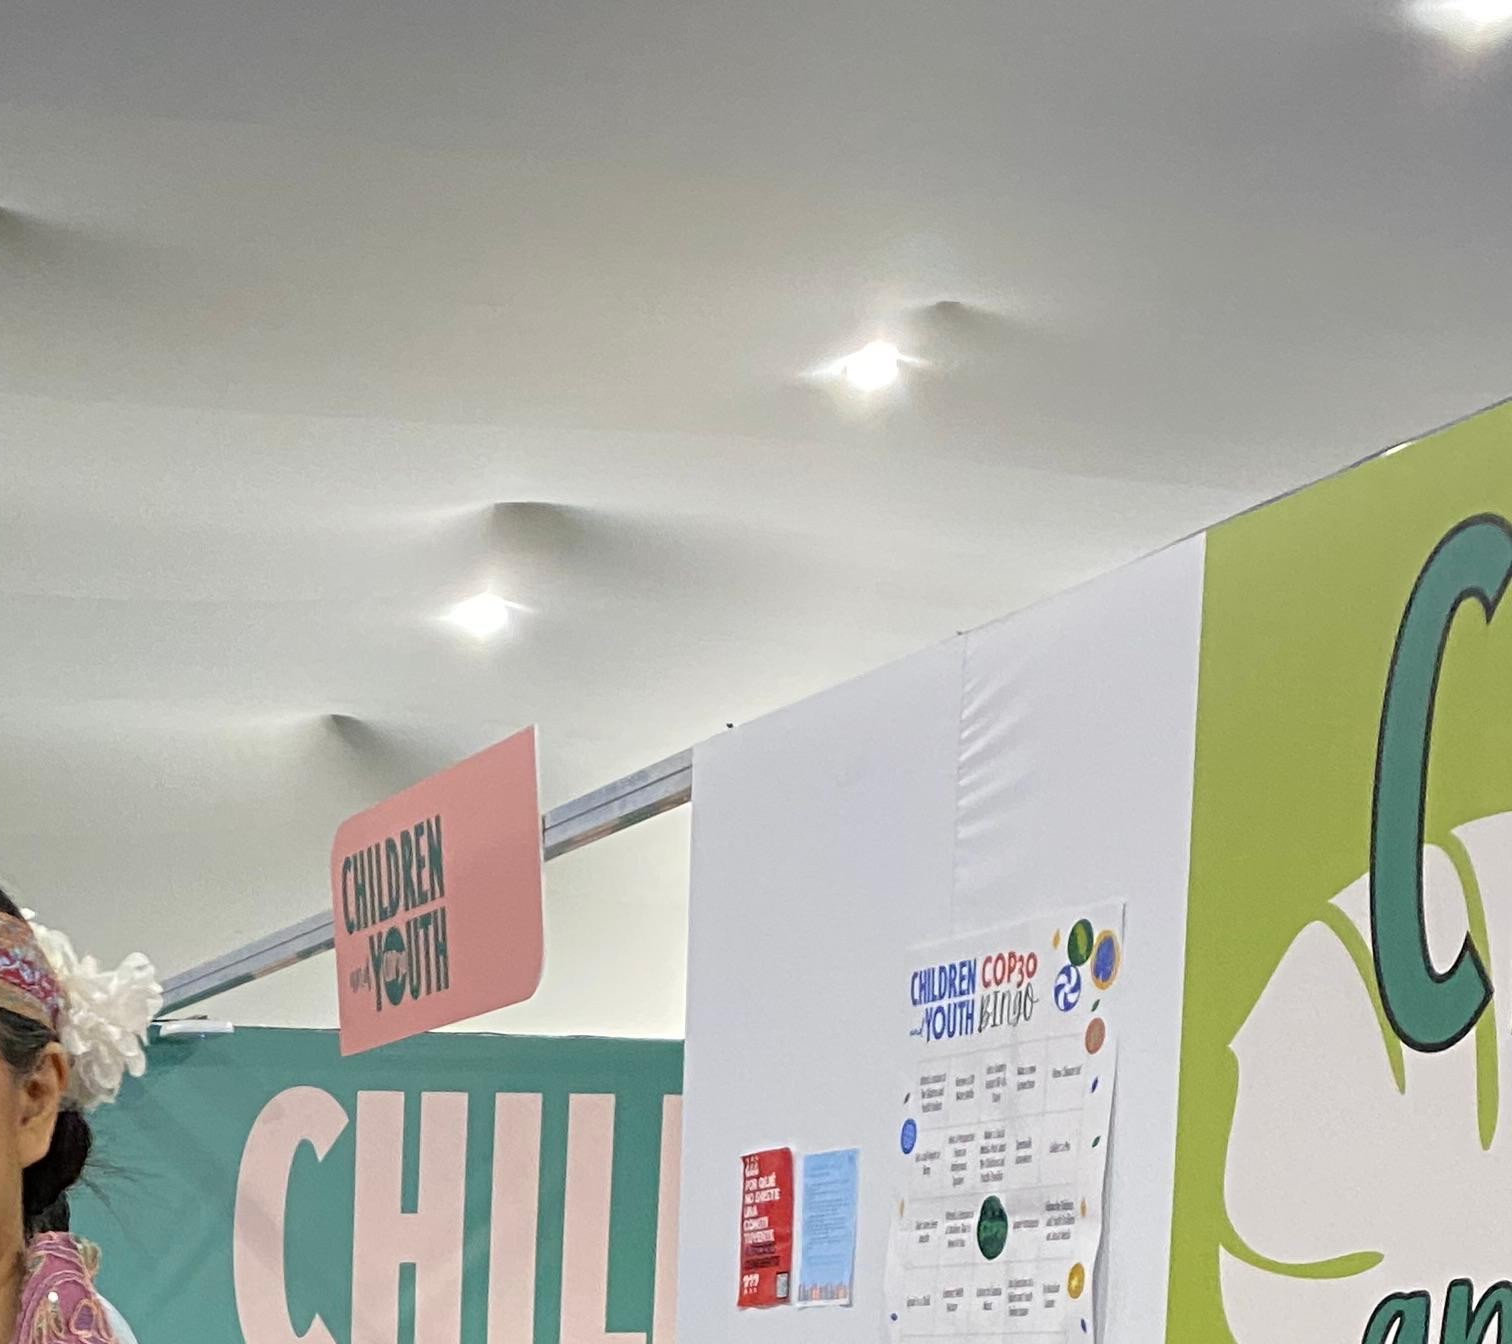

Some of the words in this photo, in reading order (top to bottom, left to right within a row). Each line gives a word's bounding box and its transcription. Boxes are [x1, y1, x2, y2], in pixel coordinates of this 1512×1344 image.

[342, 814, 445, 935] CHILDREN
[369, 905, 449, 1012] YOUTH
[910, 958, 977, 1006] CHILDREN
[982, 951, 1038, 989] COP30
[924, 1000, 975, 1042] YOUTH
